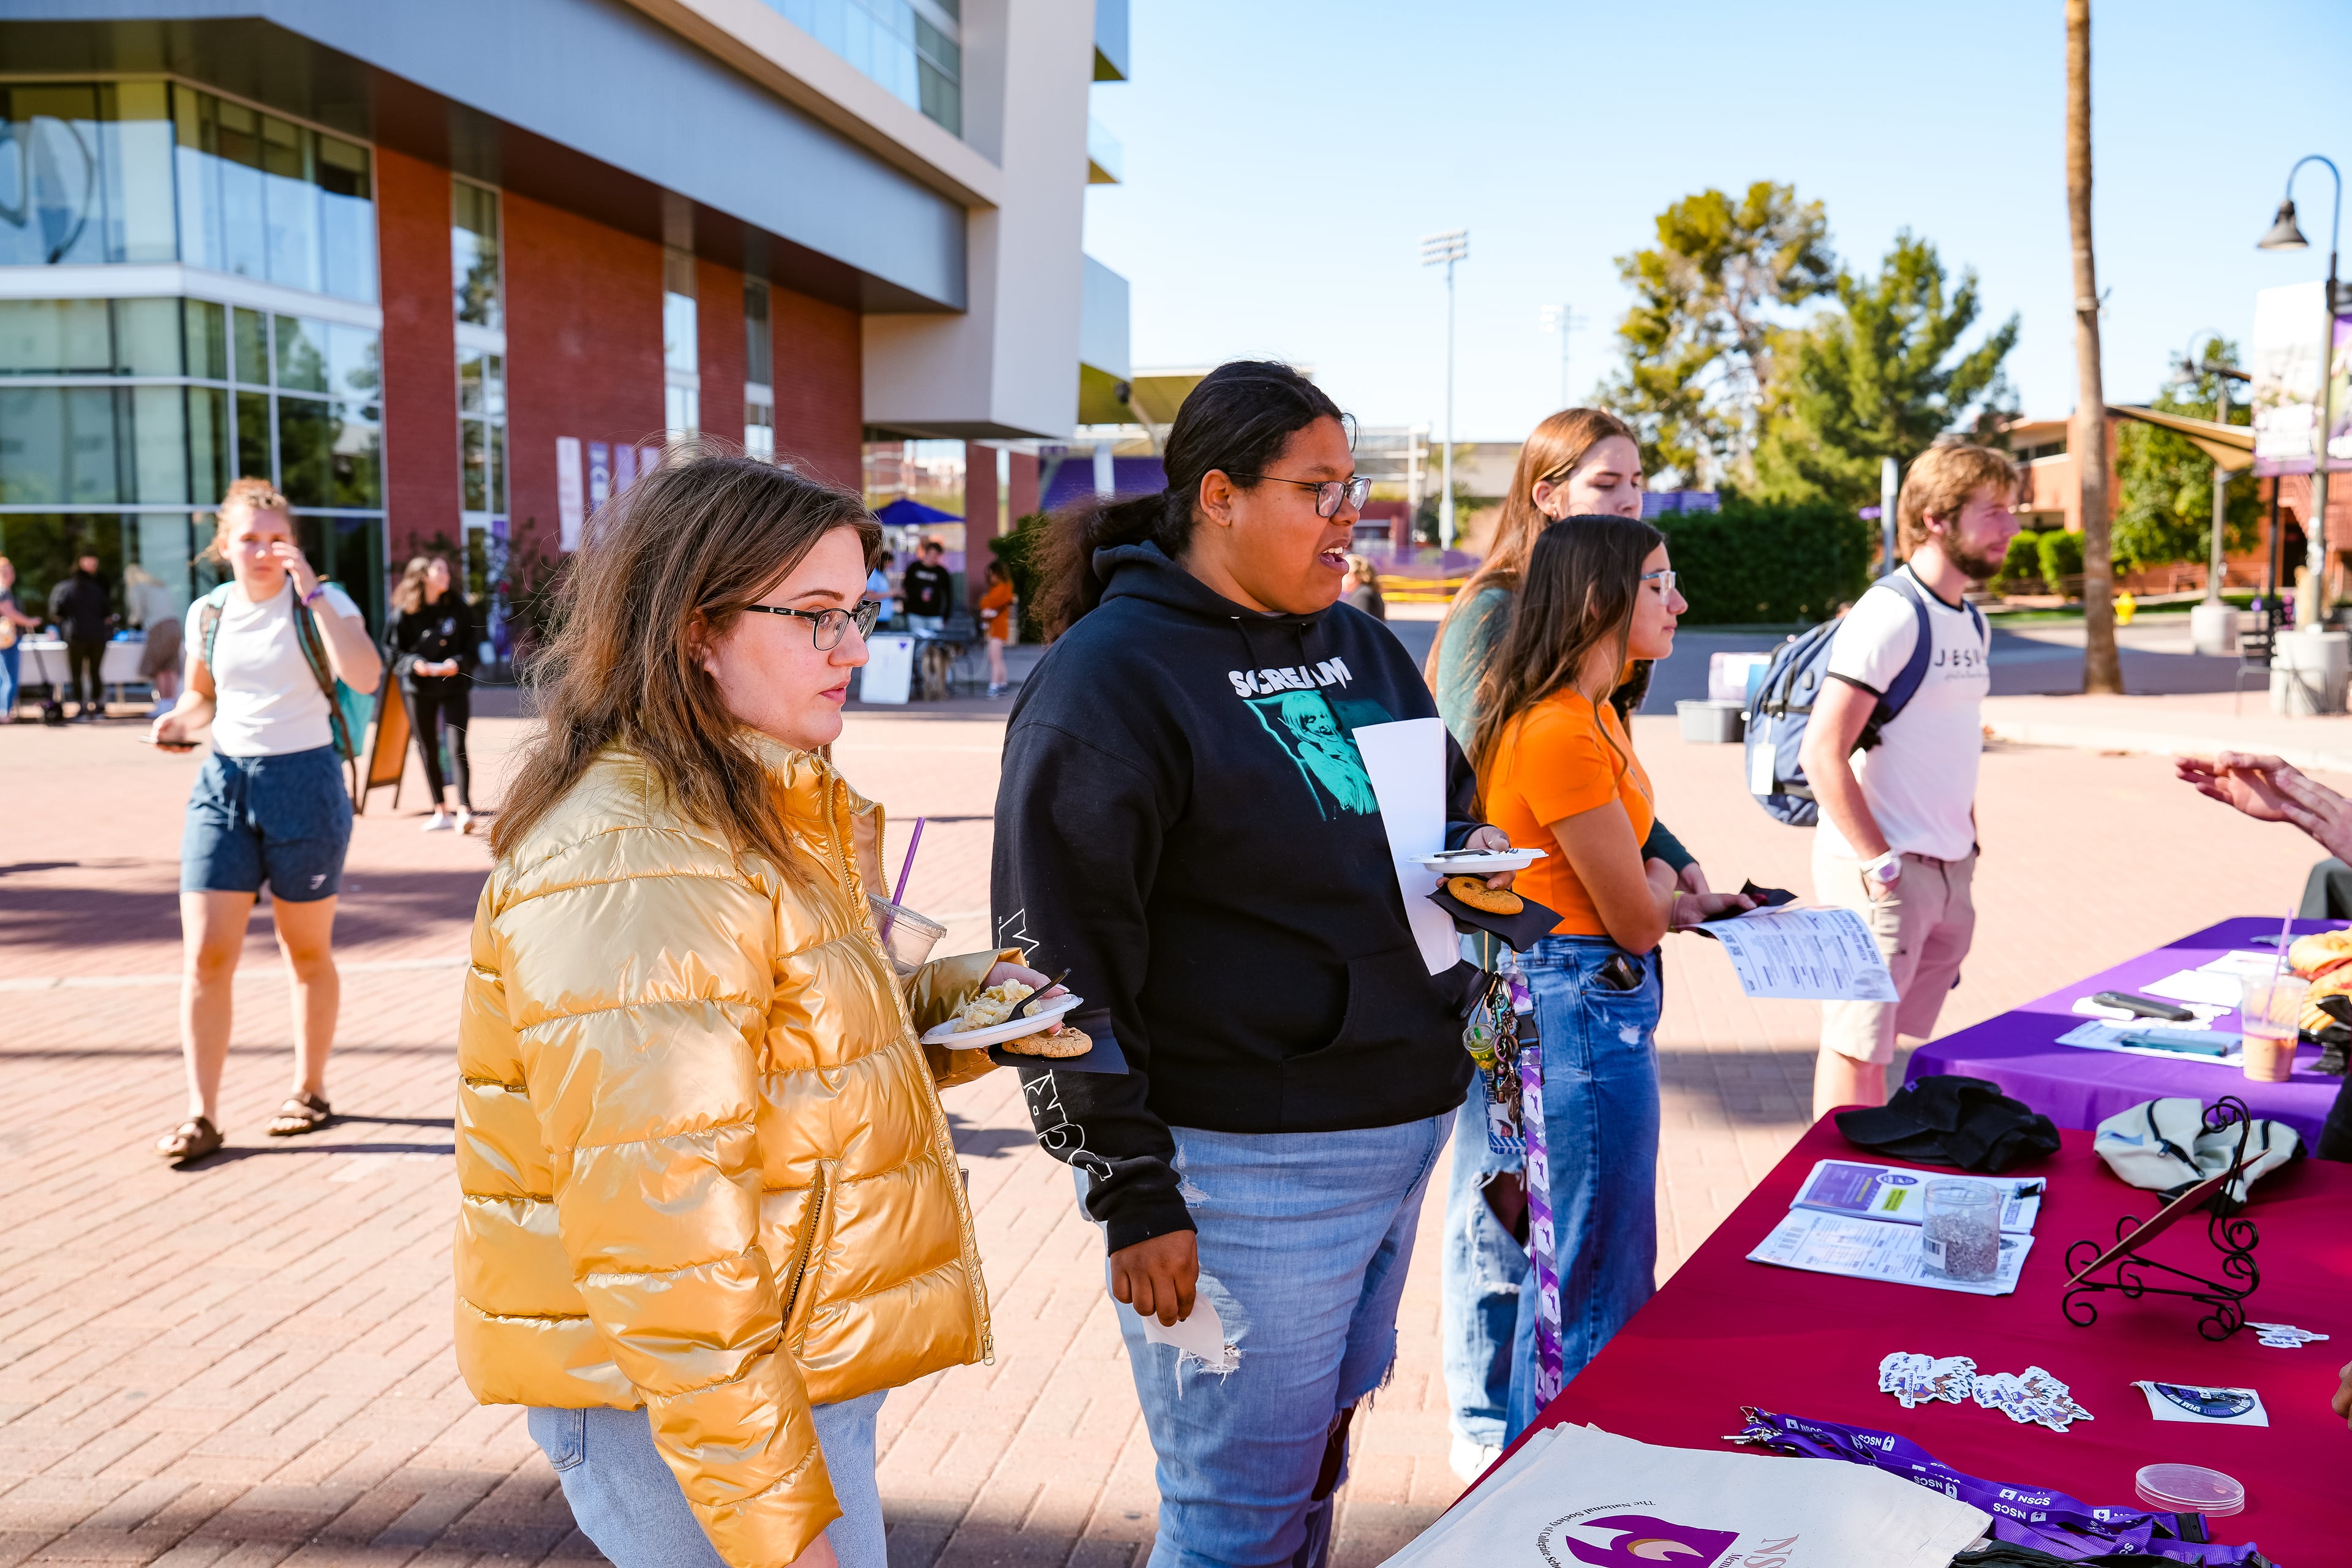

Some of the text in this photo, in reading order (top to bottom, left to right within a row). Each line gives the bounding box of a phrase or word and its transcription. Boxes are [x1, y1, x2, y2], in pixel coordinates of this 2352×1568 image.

[1228, 656, 1353, 698] SCREAM
[2181, 1401, 2201, 1412] SPEAK
[1858, 1434, 1882, 1447] NSCS
[1913, 1476, 1943, 1490] NSCS
[2018, 1494, 2051, 1506] NSCS
[1583, 1502, 1632, 1515] National
[1993, 1502, 2027, 1520] NSCS
[1549, 1511, 1585, 1527] Society
[1536, 1532, 1551, 1556] Collegiate
[1743, 1534, 1800, 1568] NS
